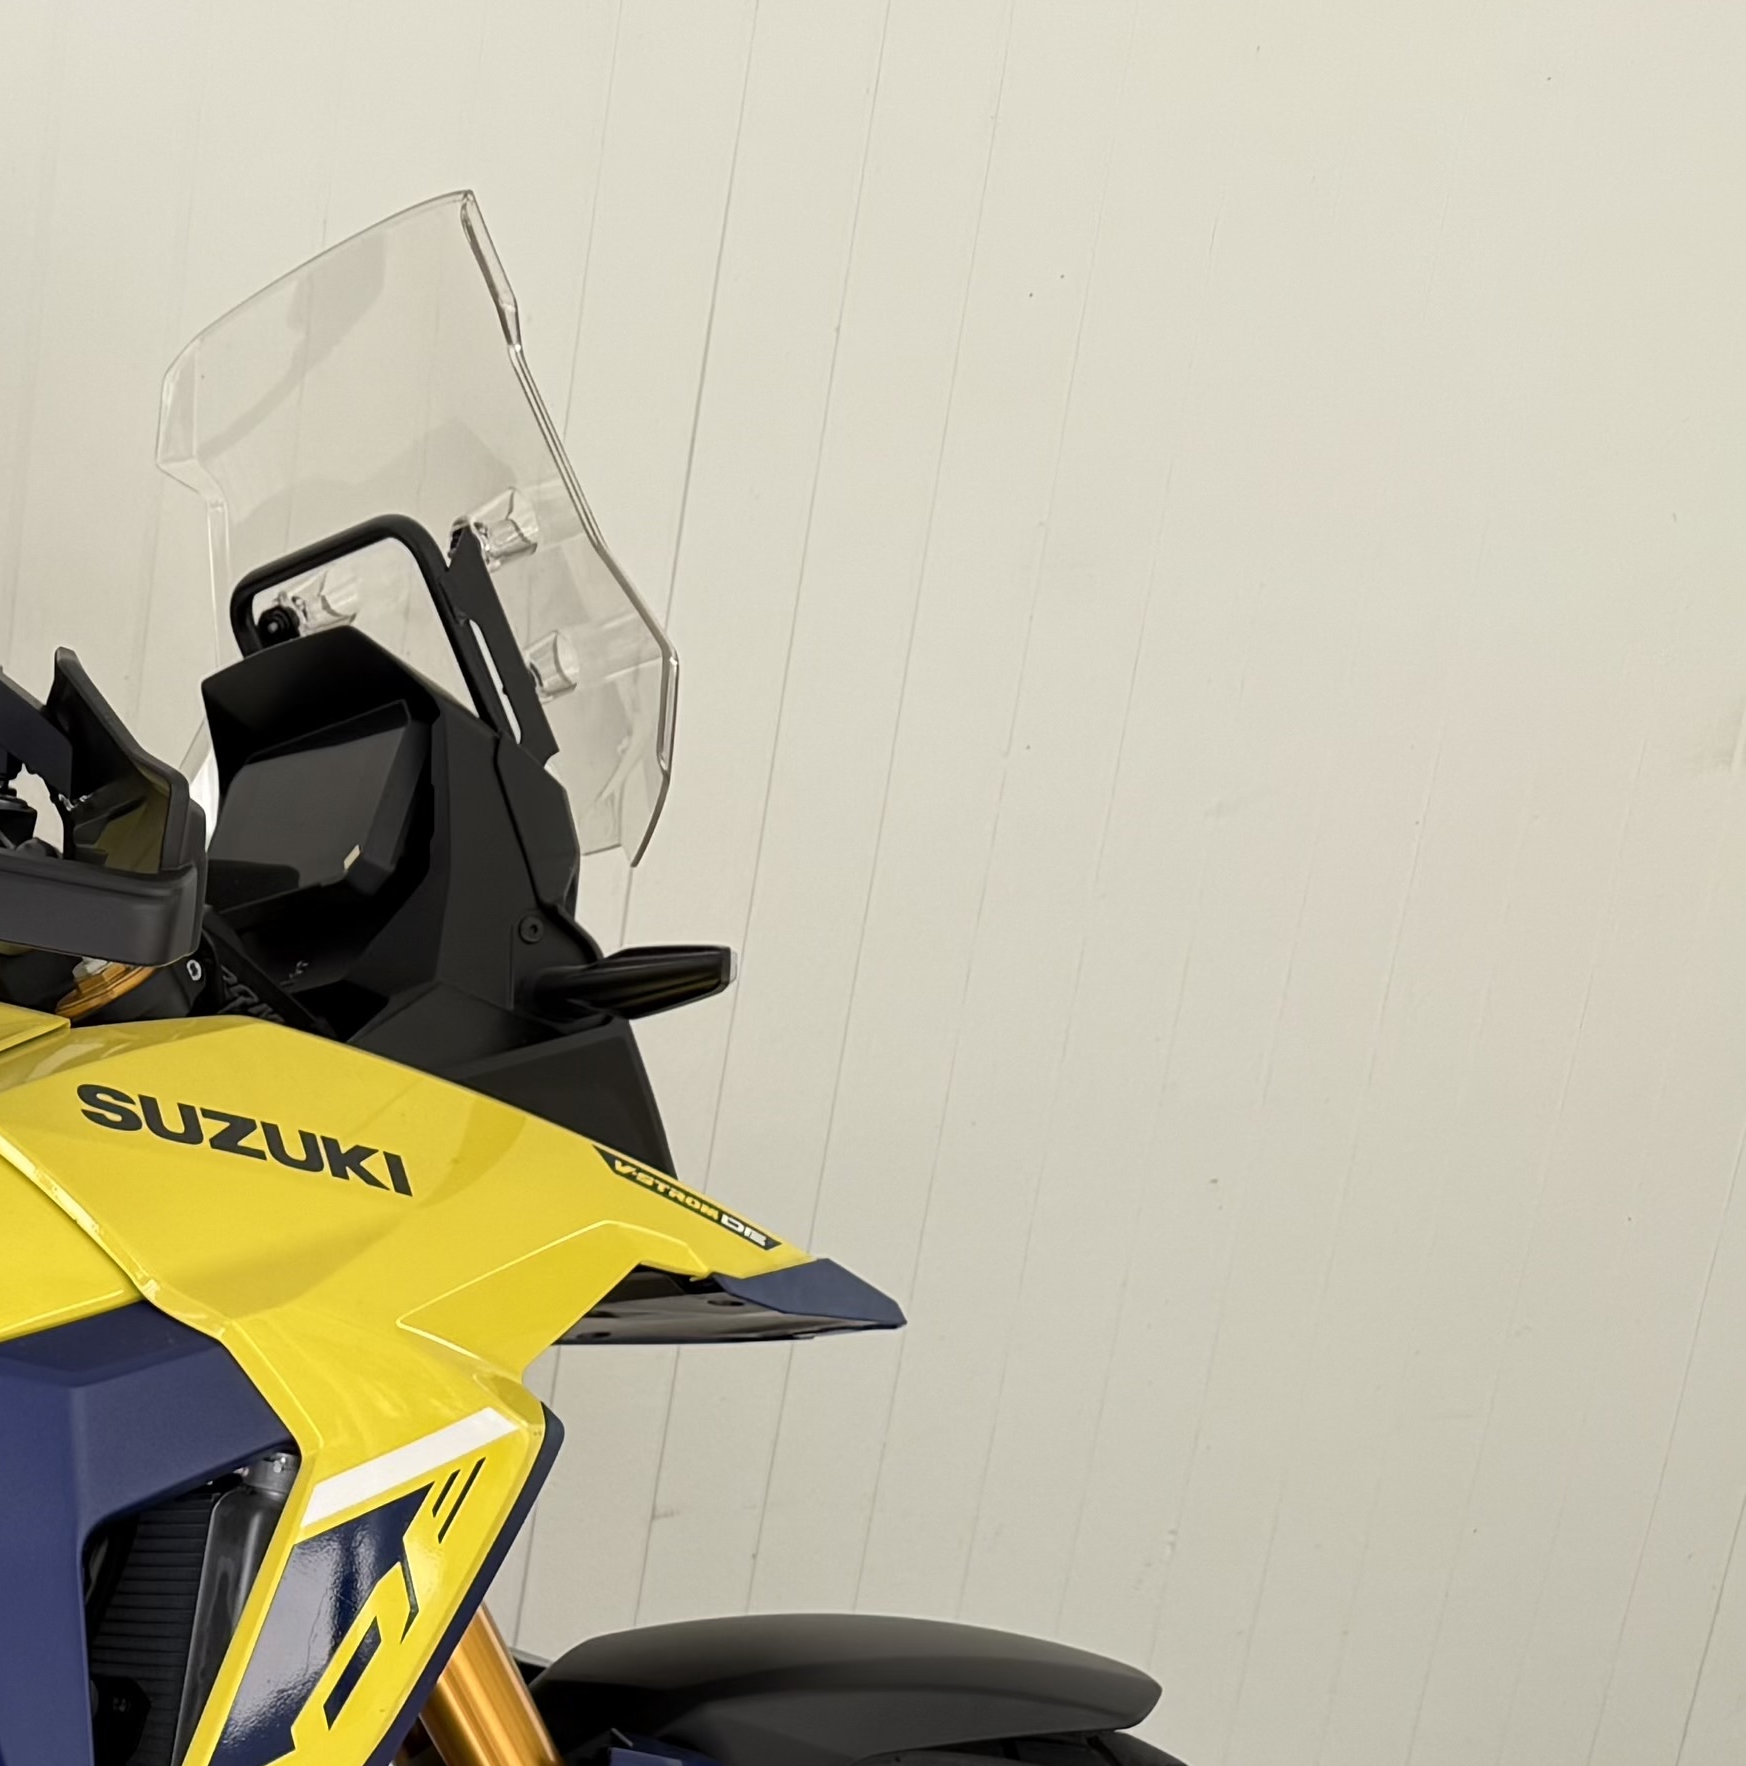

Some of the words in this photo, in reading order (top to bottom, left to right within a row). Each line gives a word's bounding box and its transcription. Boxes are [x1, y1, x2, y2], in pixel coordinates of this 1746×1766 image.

[76, 1083, 413, 1197] SUZUKI
[614, 1159, 720, 1220] V-STROM
[721, 1214, 768, 1246] DE
